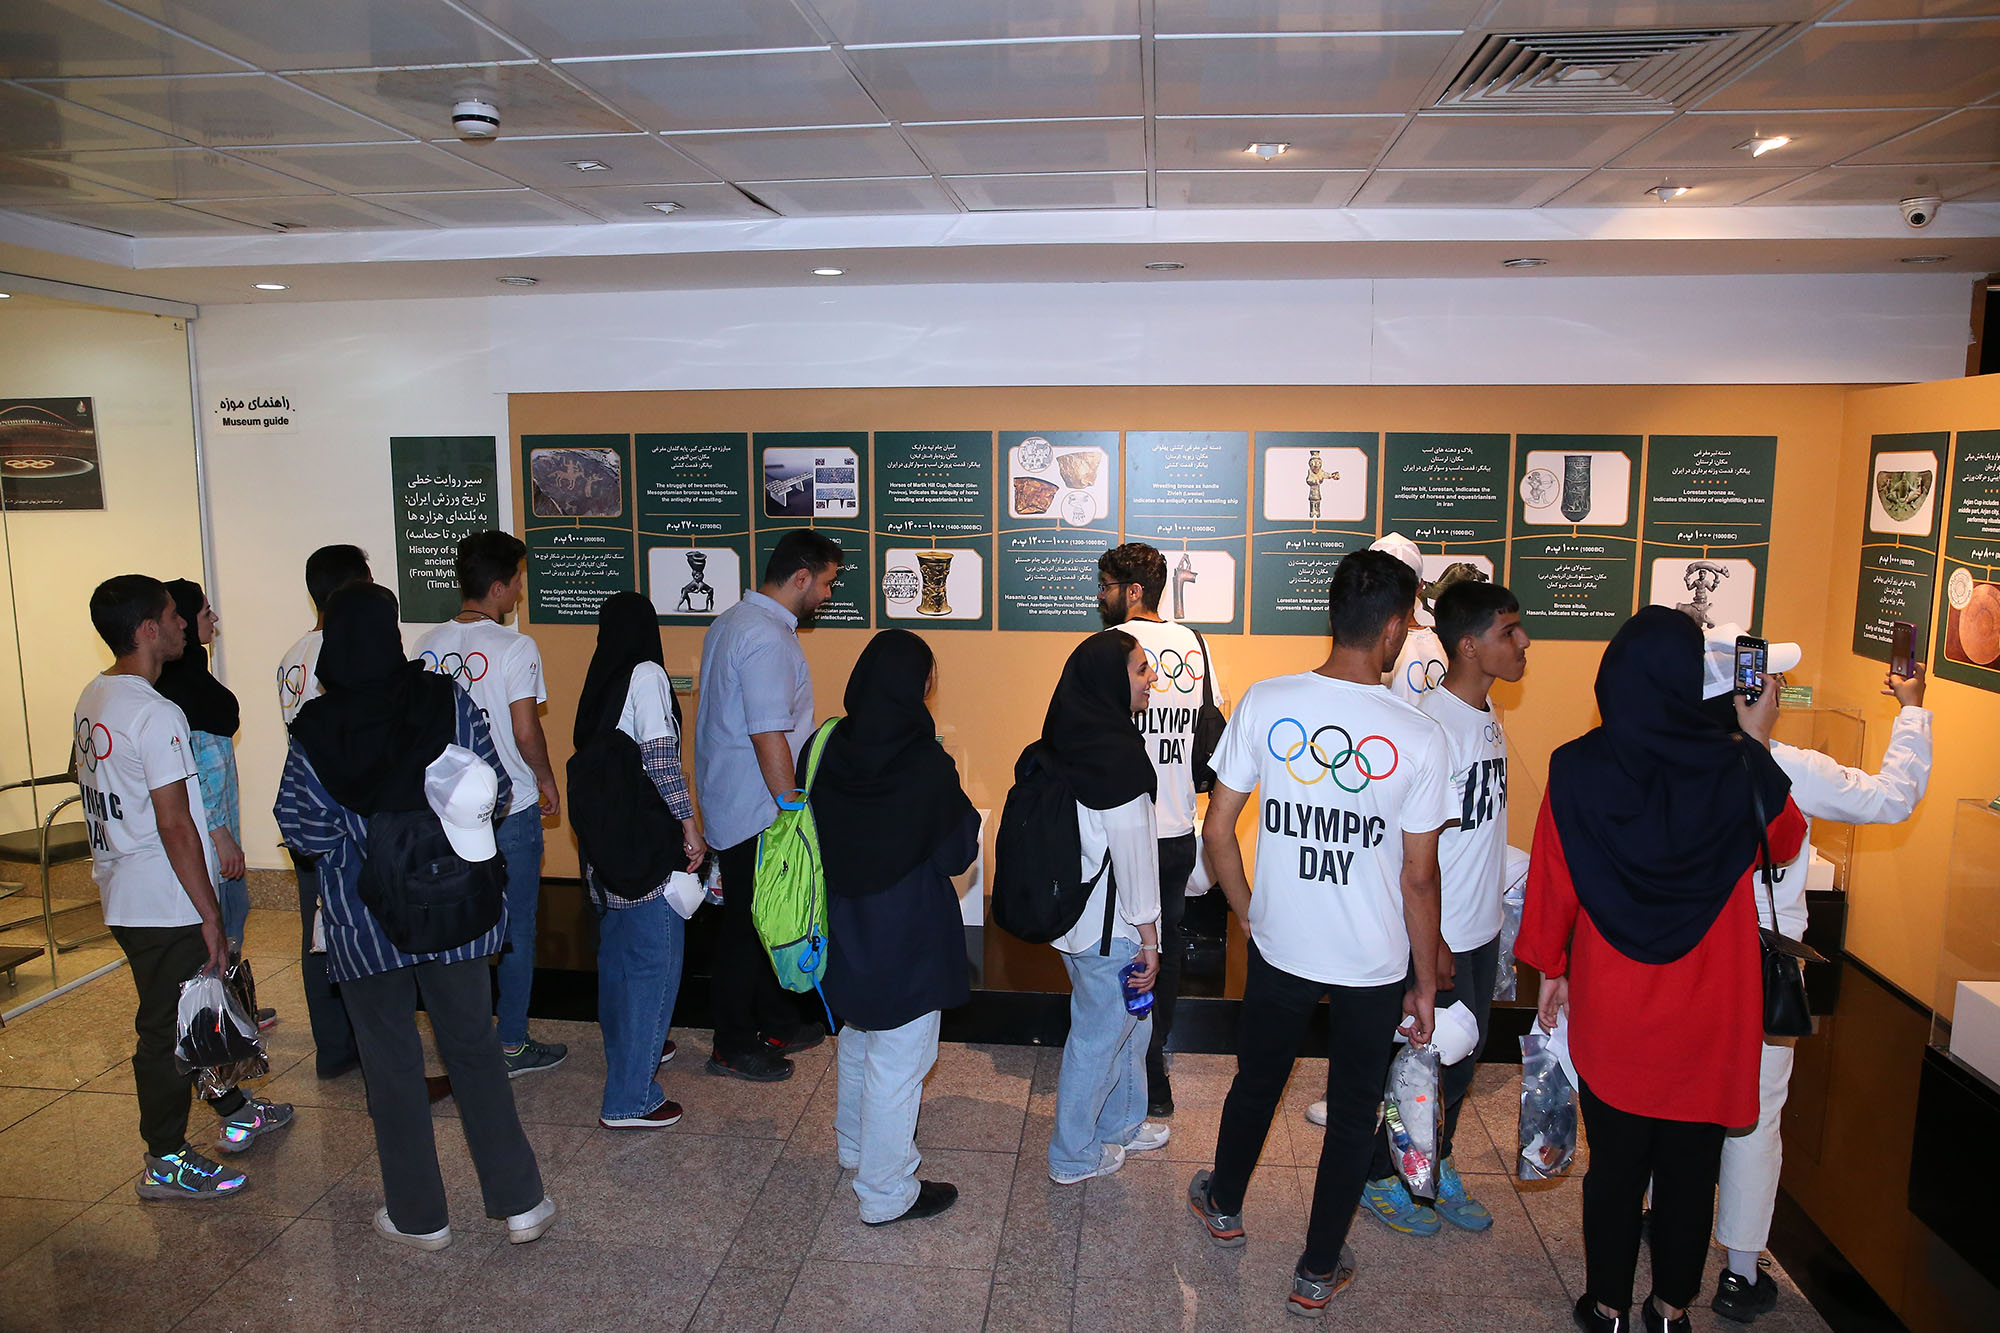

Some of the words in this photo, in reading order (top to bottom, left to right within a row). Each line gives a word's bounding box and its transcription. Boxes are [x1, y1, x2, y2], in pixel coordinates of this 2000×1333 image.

[220, 397, 244, 411] موزه
[248, 396, 290, 411] راهنمای
[223, 417, 261, 426] Museum
[263, 416, 289, 427] guide
[407, 474, 432, 488] خطی
[434, 474, 461, 488] روایت
[464, 474, 482, 488] سیر
[432, 492, 460, 506] ورزش
[461, 492, 487, 506] تاریخ
[407, 511, 417, 520] ها
[420, 511, 444, 524] هزاره
[478, 514, 487, 524] به
[681, 521, 699, 529] ۲۷۰۰
[1175, 523, 1190, 531] ۱۰۰۰
[442, 529, 449, 539] تا
[1433, 526, 1449, 535] ۱۰۰۰
[1696, 530, 1711, 539] ۱۰۰۰
[568, 534, 583, 542] ۹۰۰۰
[1303, 539, 1319, 547] ۱۰۰۰
[409, 546, 438, 555] History
[440, 546, 449, 554] of
[1563, 543, 1579, 552] ۱۰۰۰
[409, 569, 434, 578] (From
[435, 569, 455, 578] Myth
[427, 580, 449, 590] (Time
[1265, 798, 1386, 848] OLYMPIC
[1299, 845, 1355, 886] DAY
